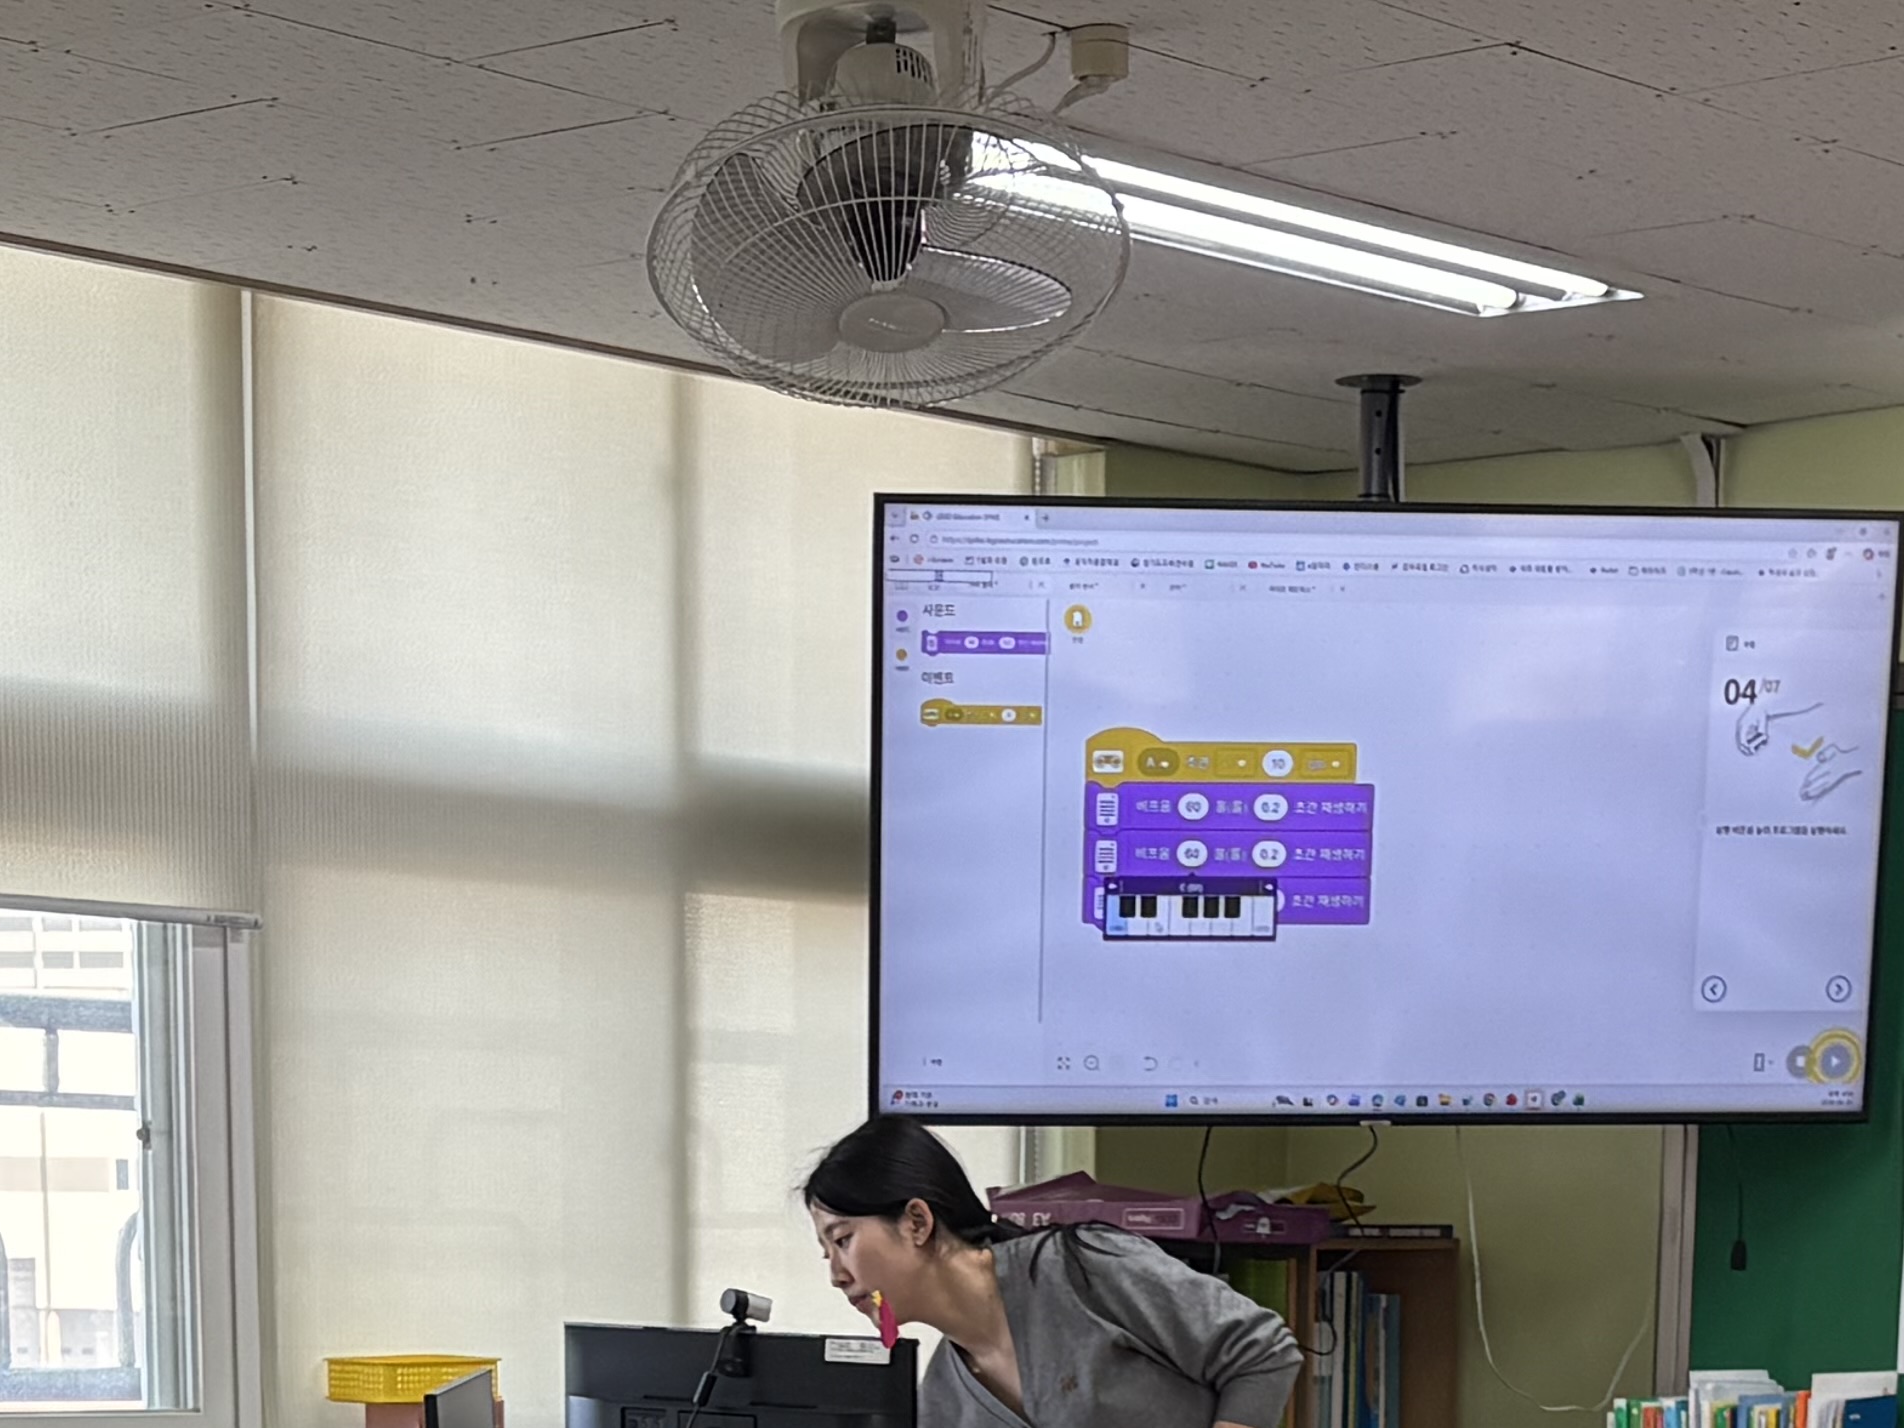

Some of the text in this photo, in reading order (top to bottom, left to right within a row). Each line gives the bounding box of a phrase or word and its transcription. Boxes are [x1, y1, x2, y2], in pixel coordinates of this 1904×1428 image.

[922, 604, 956, 617] 사운드
[1724, 679, 1758, 705] 04
[1272, 759, 1286, 768] 10
[1261, 802, 1281, 813] 0.2
[1259, 848, 1280, 860] 0.2
